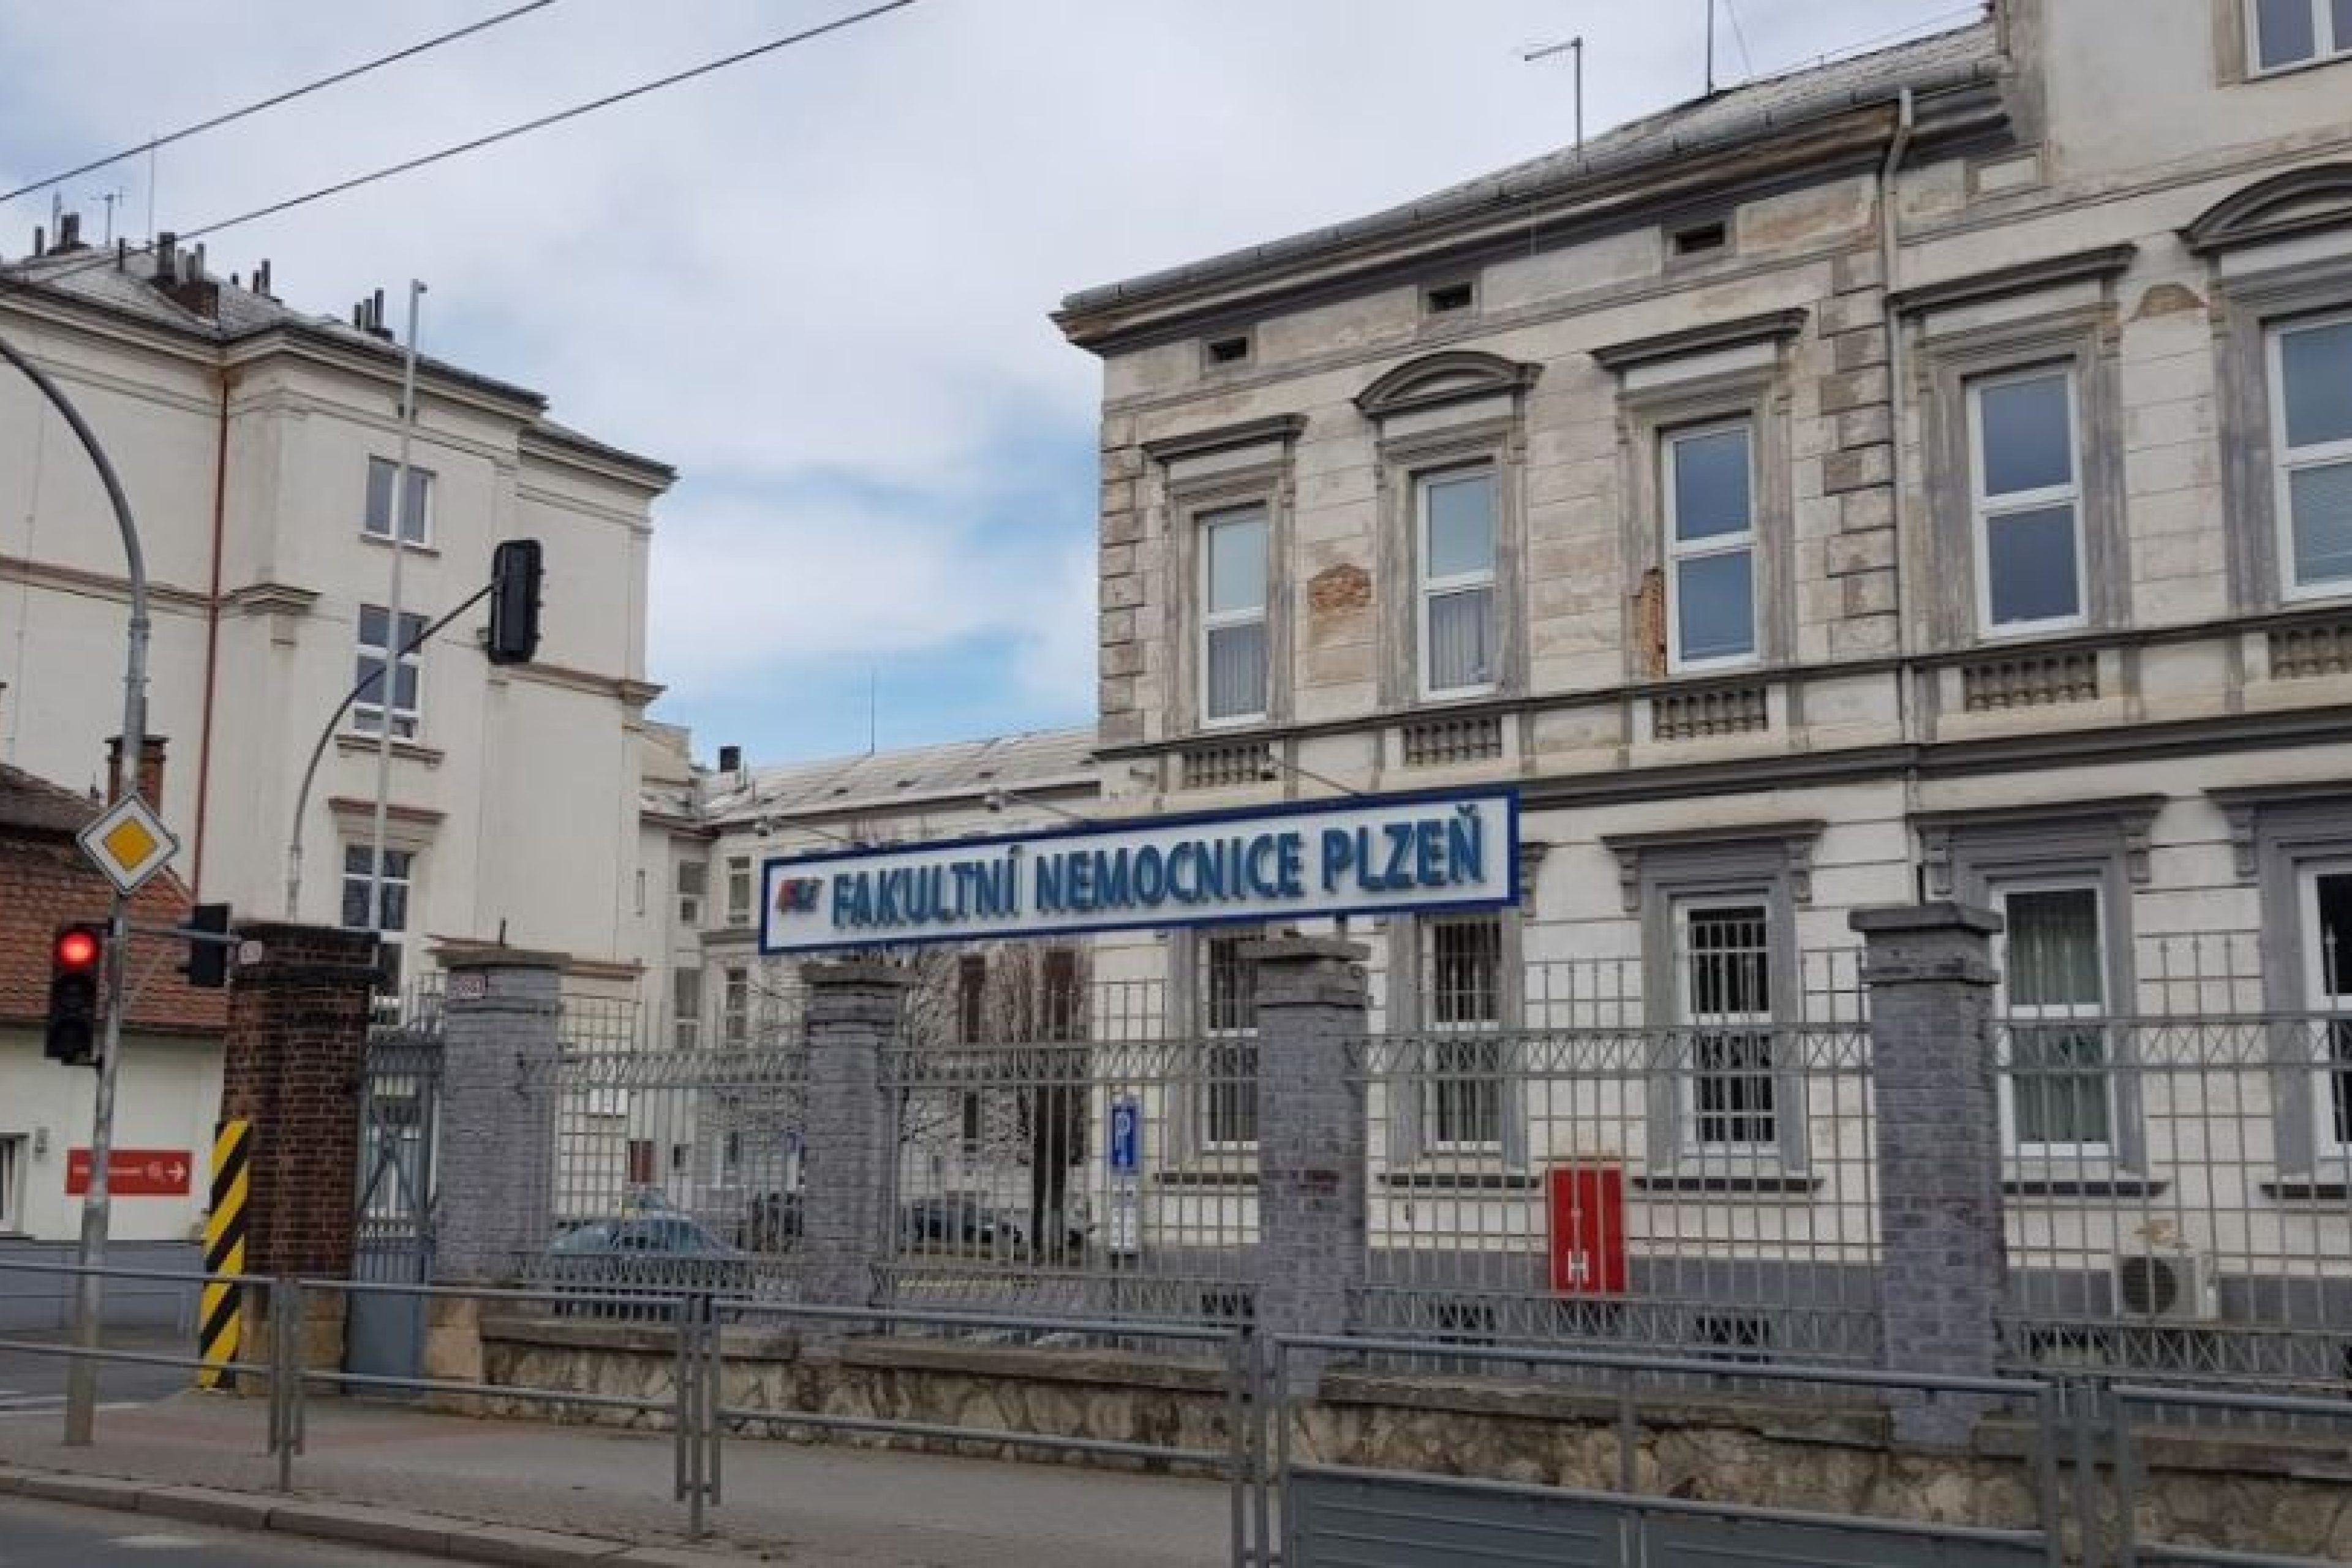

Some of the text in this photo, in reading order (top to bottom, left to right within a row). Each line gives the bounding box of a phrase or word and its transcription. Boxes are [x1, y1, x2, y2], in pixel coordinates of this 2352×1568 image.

[832, 845, 1022, 928] FAKULTNÍ
[1036, 831, 1303, 913] NEMOCNICE
[1321, 804, 1485, 894] PLZEŇ
[1568, 1250, 1589, 1283] H
